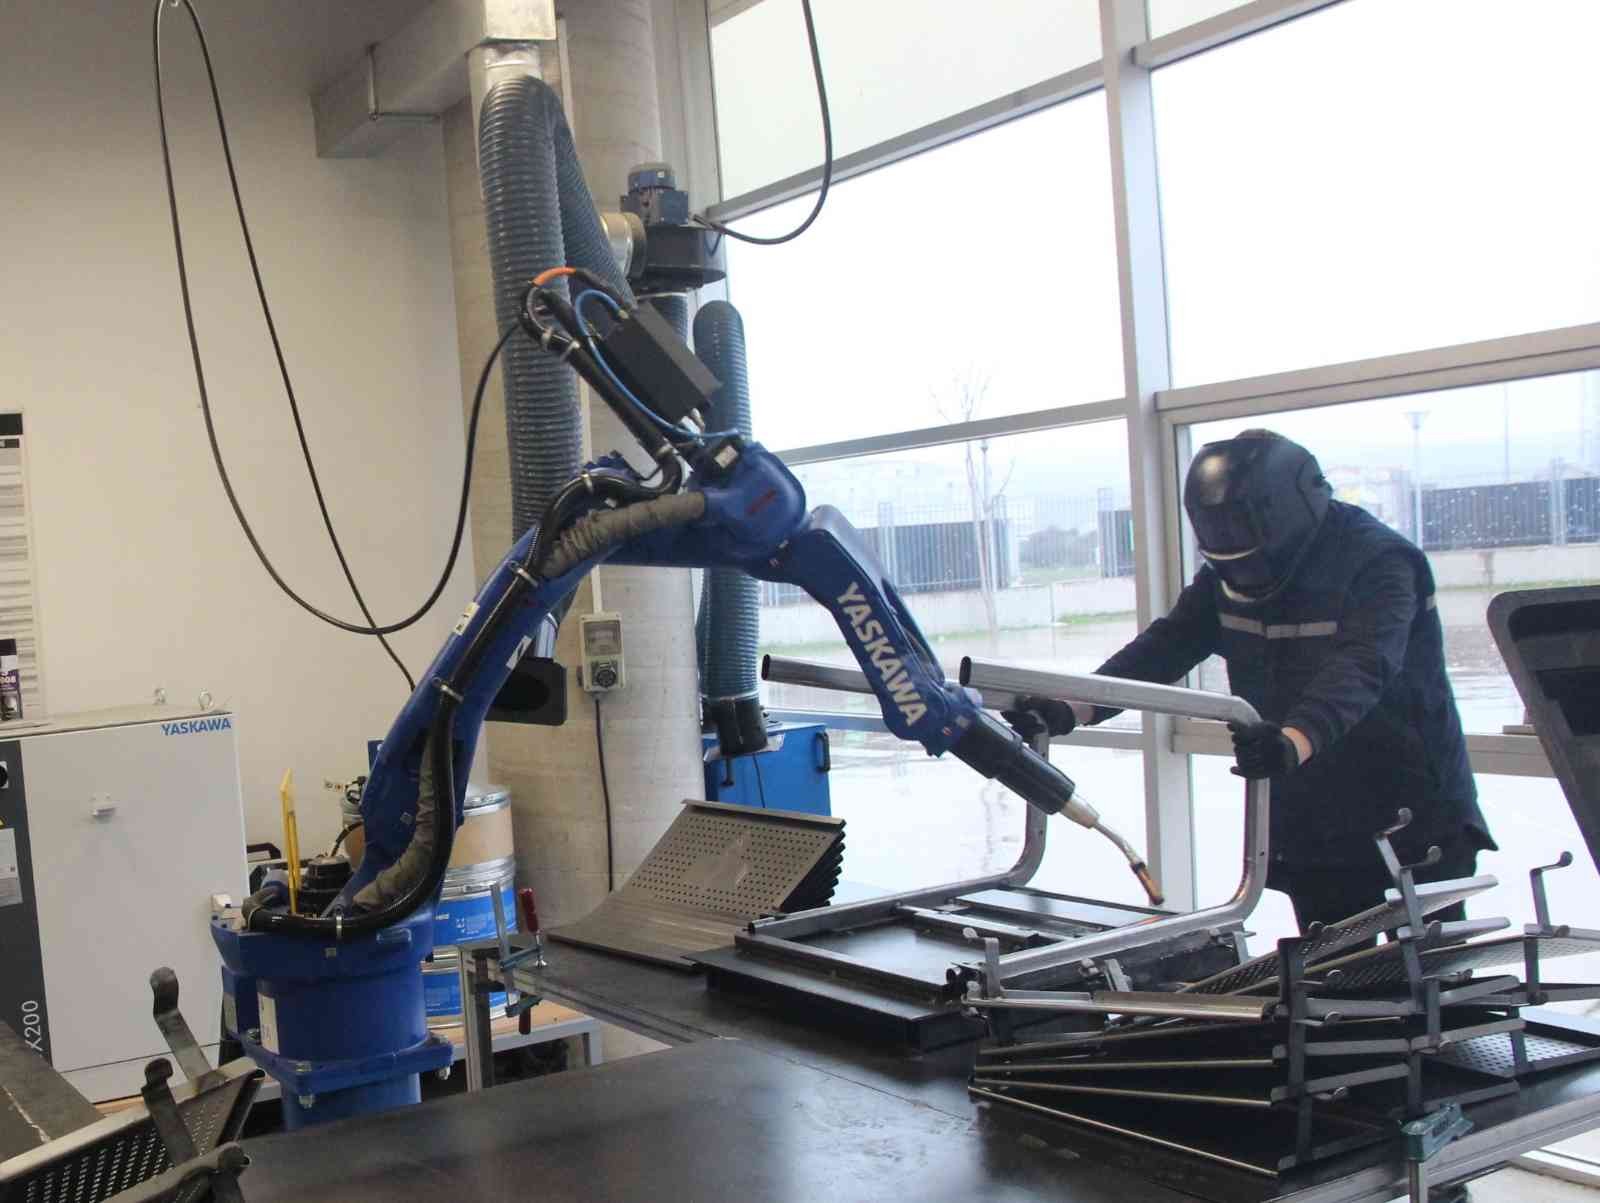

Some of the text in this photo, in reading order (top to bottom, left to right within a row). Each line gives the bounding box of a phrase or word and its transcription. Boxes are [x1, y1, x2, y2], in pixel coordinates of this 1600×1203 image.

[837, 581, 927, 727] YASKAWA
[161, 718, 232, 736] YASKAWA
[21, 1000, 43, 1058] X200
